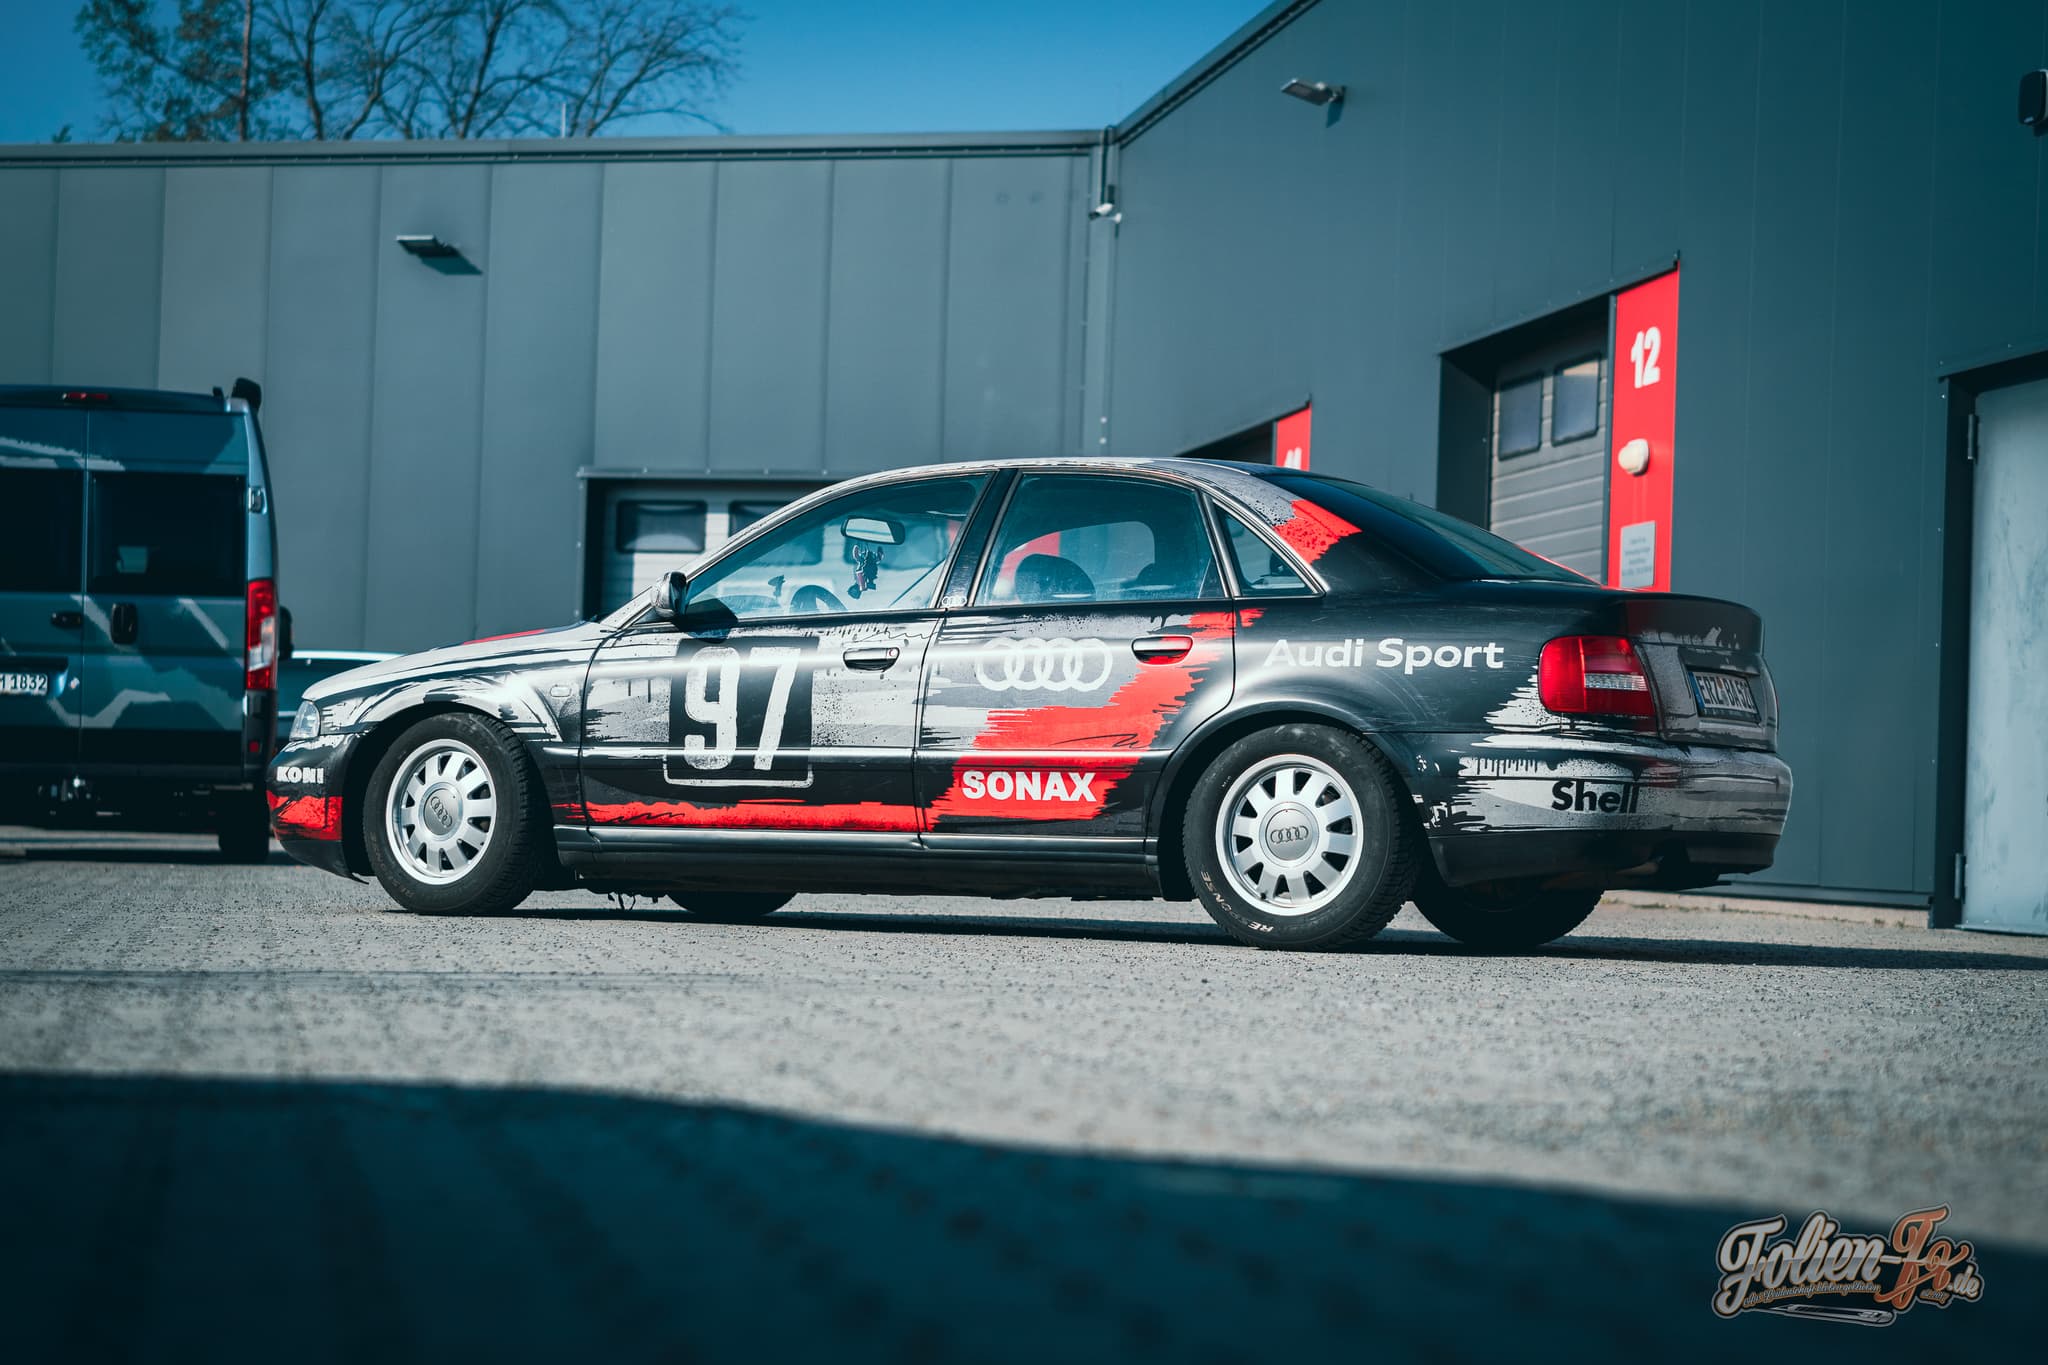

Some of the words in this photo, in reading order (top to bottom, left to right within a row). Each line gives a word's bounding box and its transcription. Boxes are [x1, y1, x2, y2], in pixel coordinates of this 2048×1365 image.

[1630, 326, 1661, 389] 12
[1263, 638, 1365, 667] Audi
[1376, 637, 1505, 675] Sport
[684, 646, 801, 771] 97
[276, 766, 324, 784] KONI
[962, 770, 1097, 802] SONAX
[1551, 779, 1641, 813] Shell
